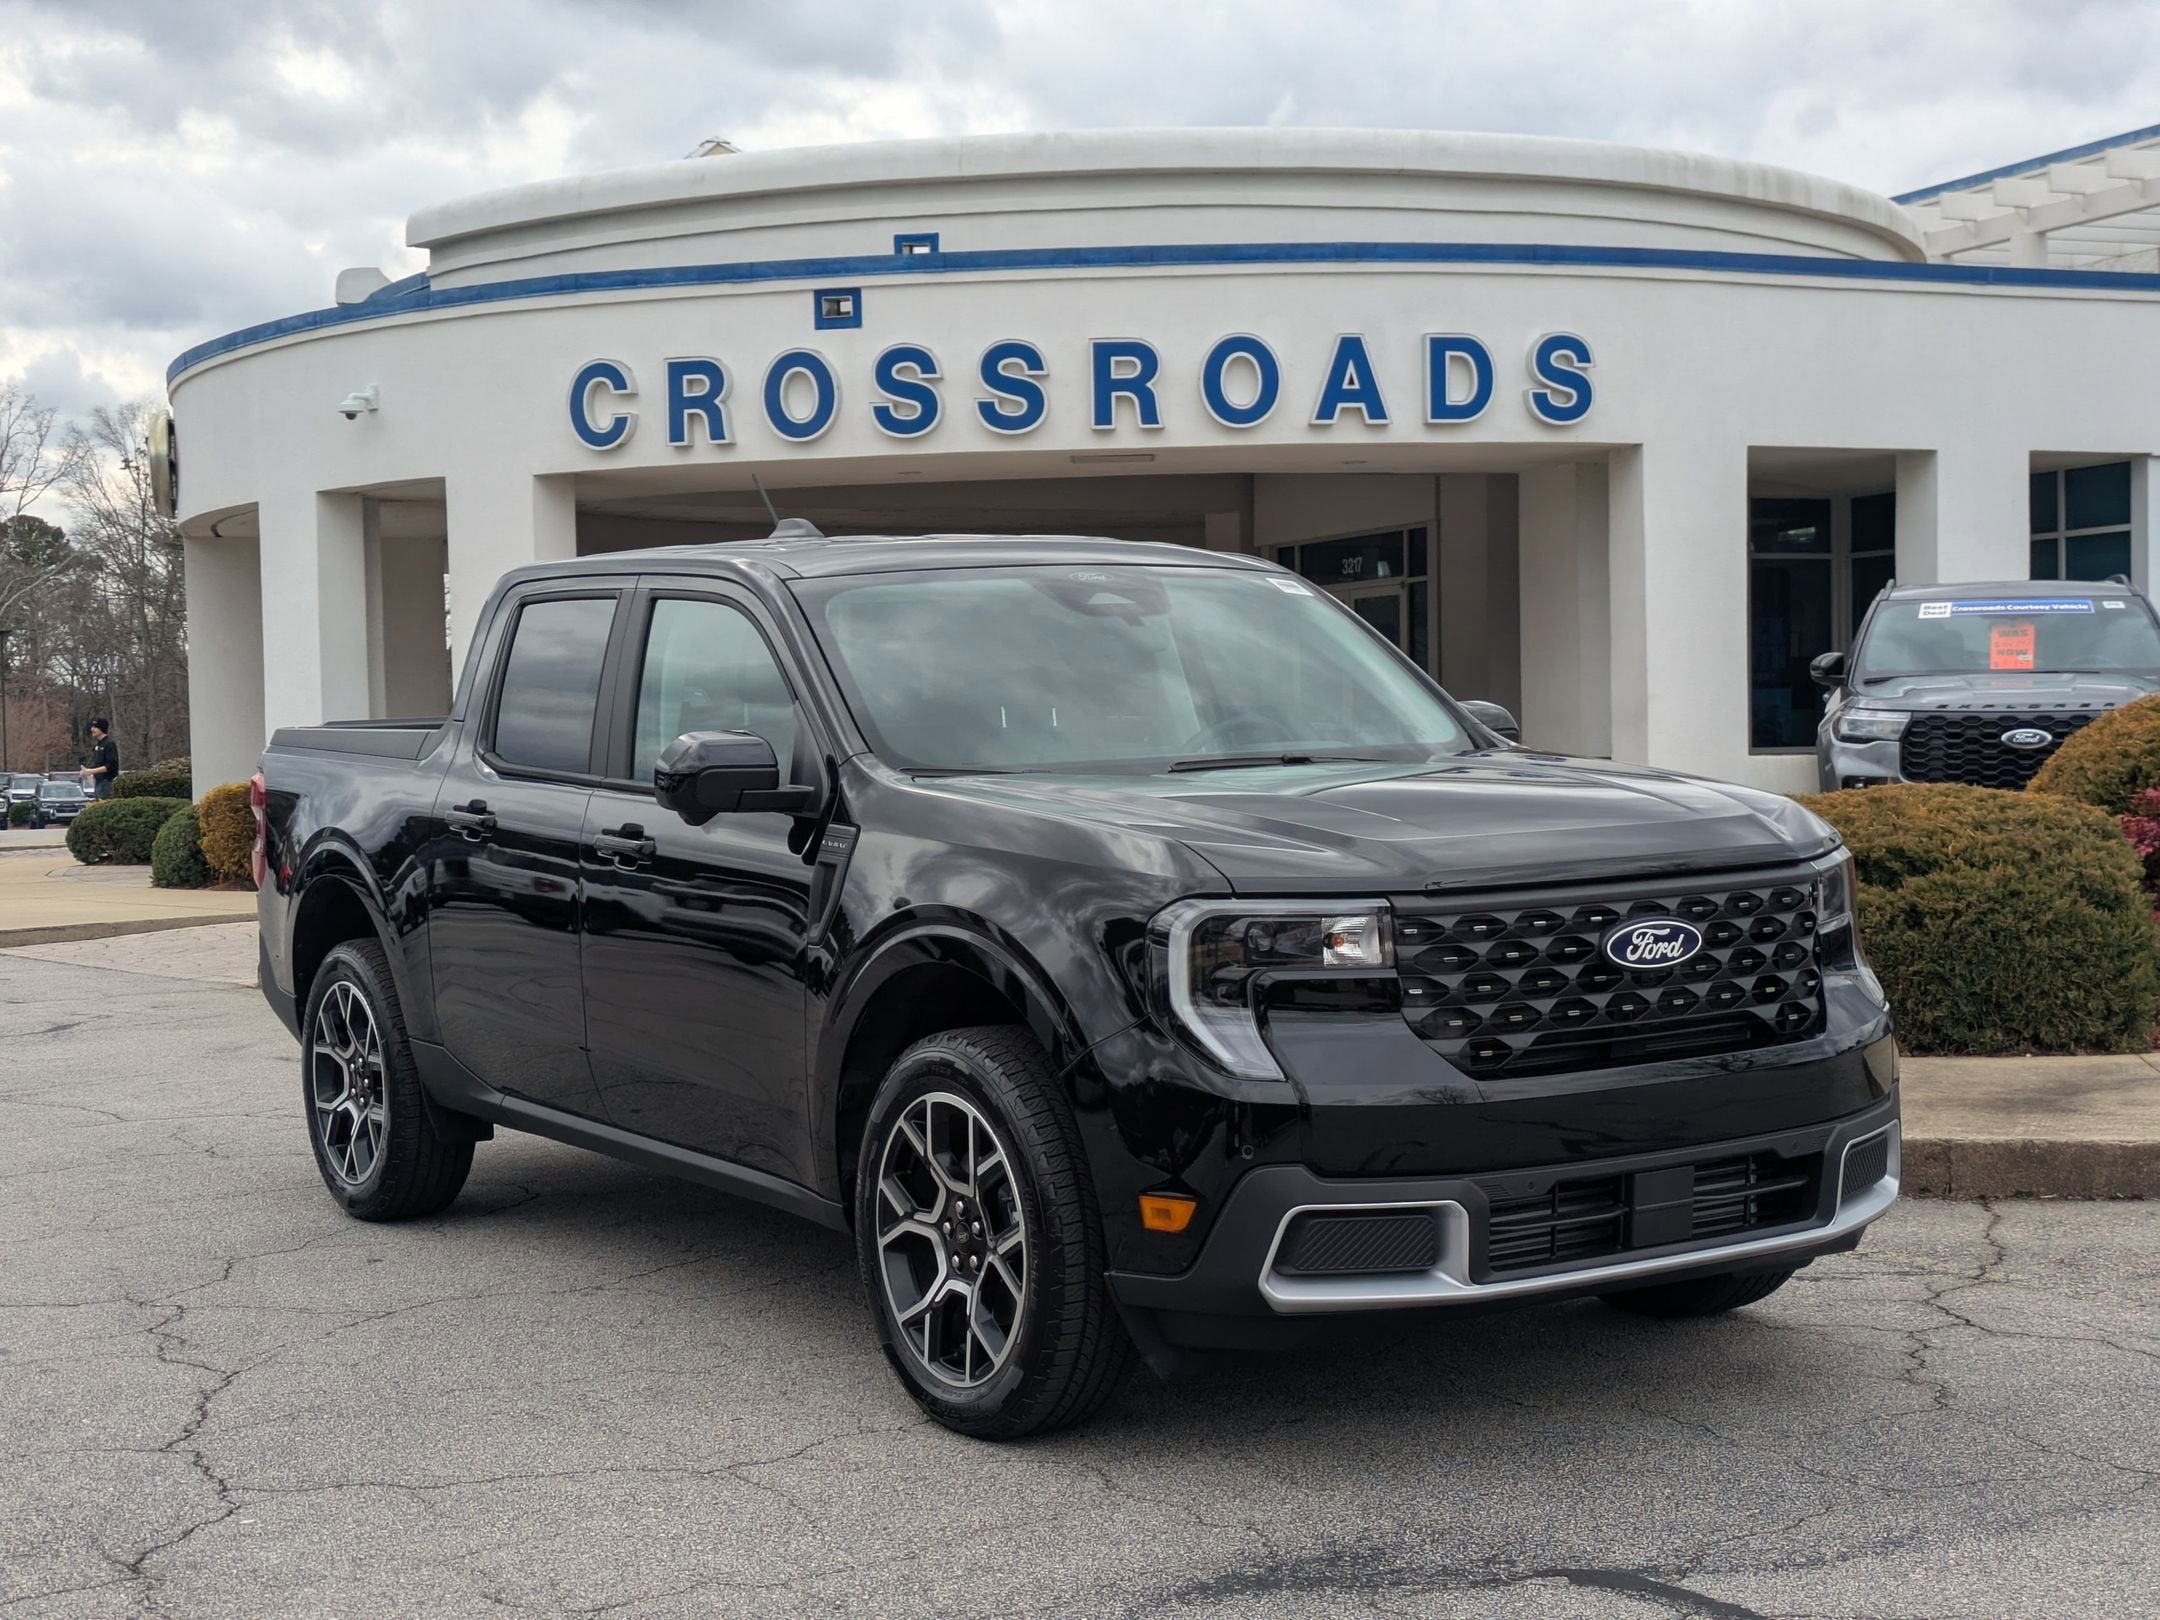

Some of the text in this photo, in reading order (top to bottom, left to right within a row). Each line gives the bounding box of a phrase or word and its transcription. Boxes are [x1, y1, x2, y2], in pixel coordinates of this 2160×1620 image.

[570, 333, 1594, 449] CROSSROADS
[1341, 556, 1363, 575] 3217
[1951, 602, 2089, 612] Crossroads Courtesy Vehicle
[2013, 733, 2040, 743] Ford
[1626, 928, 1684, 960] Ford
